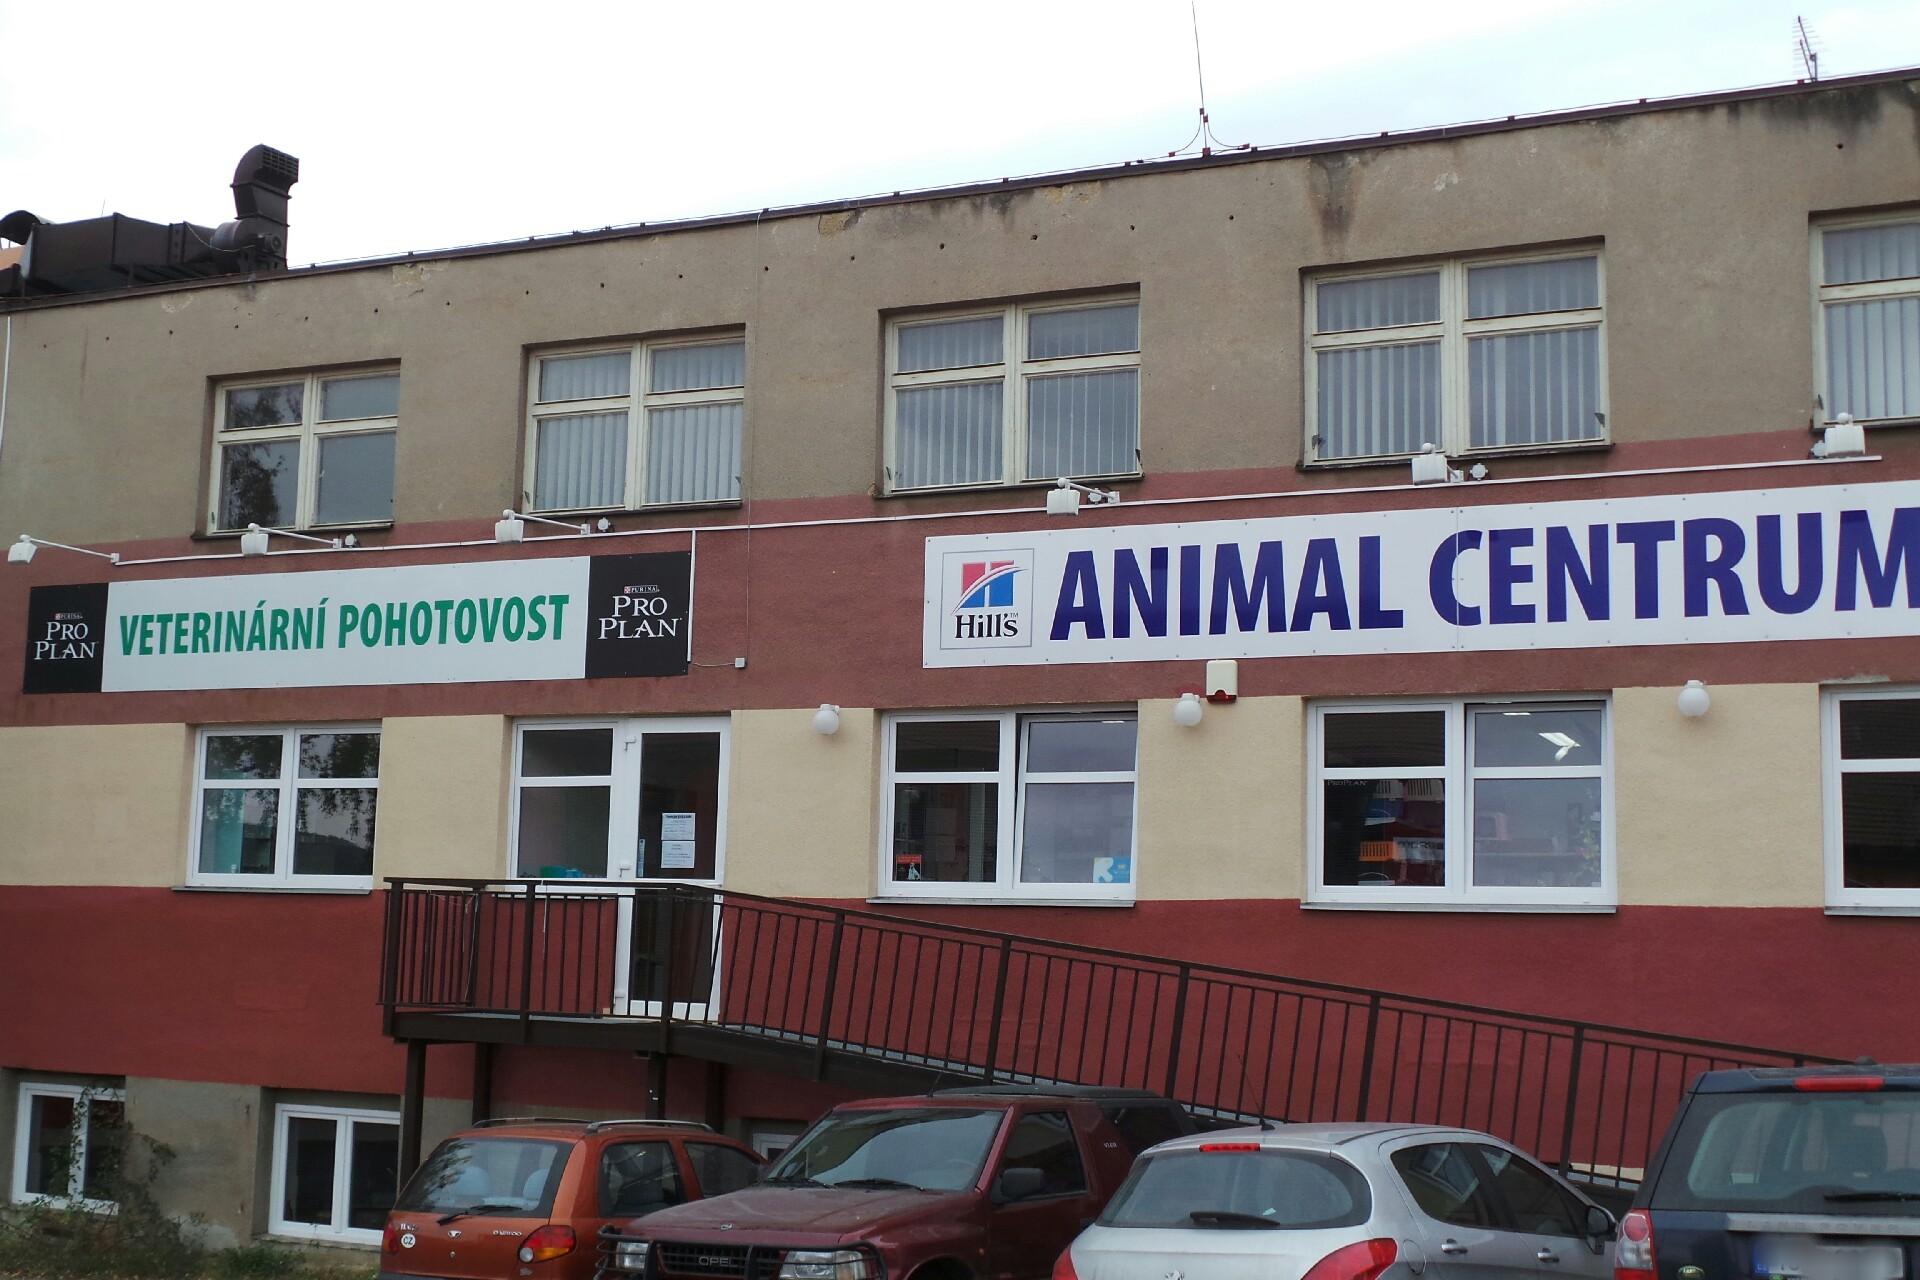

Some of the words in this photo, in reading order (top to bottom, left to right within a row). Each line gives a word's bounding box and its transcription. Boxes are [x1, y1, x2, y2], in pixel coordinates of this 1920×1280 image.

[1049, 535, 1404, 641] ANIMAL
[1428, 507, 1920, 627] CENTRUM
[612, 595, 668, 618] PRO
[44, 621, 89, 641] PRO
[120, 597, 329, 656] VETERINÁRNÍ
[338, 594, 570, 649] POHOTOVOST
[598, 617, 679, 640] PLAN
[955, 613, 1019, 639] Hill's
[34, 640, 97, 661] PLAN
[402, 1236, 414, 1246] CZ
[699, 1256, 738, 1268] OPEL
